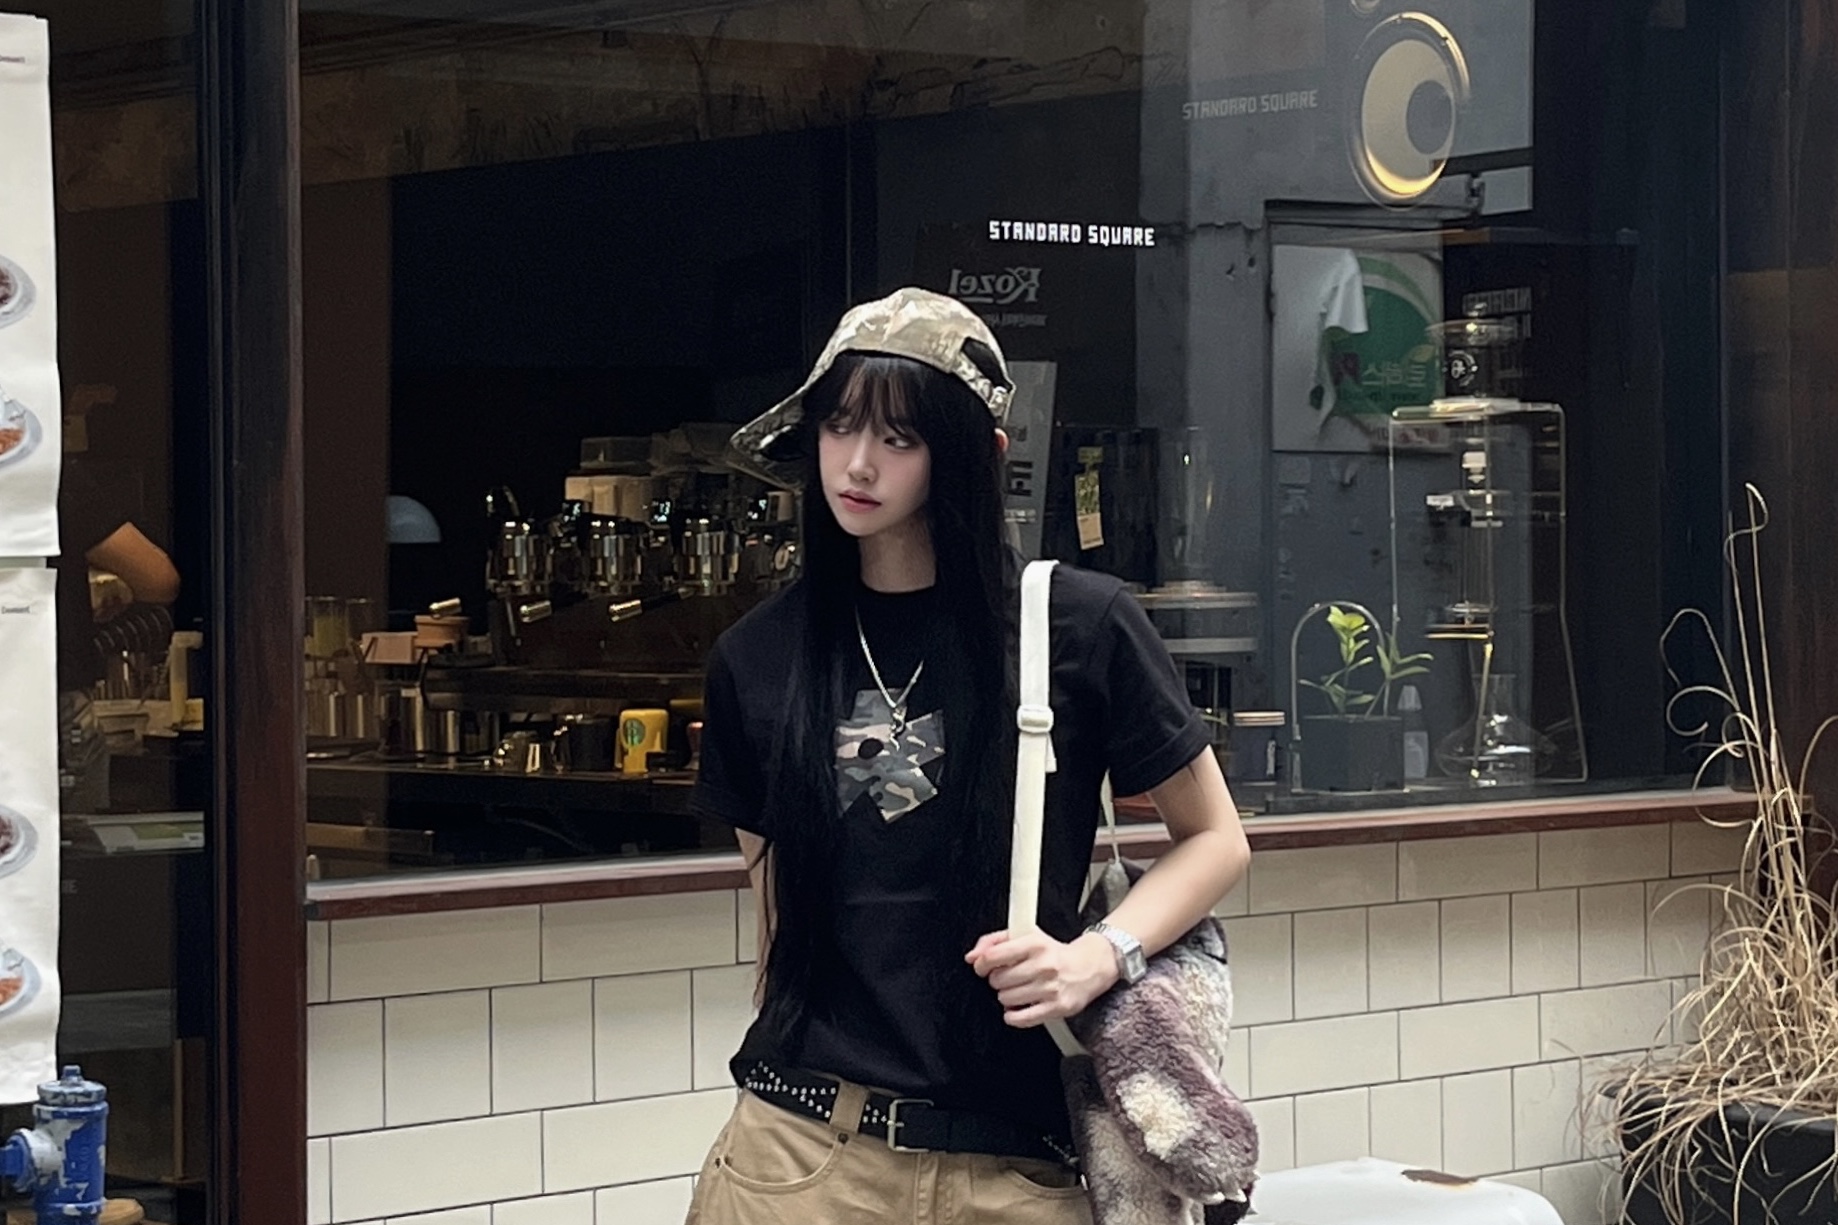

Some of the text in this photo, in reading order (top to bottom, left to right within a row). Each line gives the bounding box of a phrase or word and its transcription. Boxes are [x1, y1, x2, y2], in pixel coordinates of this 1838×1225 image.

[1182, 90, 1318, 120] STANDARD SQUARE
[989, 220, 1155, 247] STANDARD SQUARE
